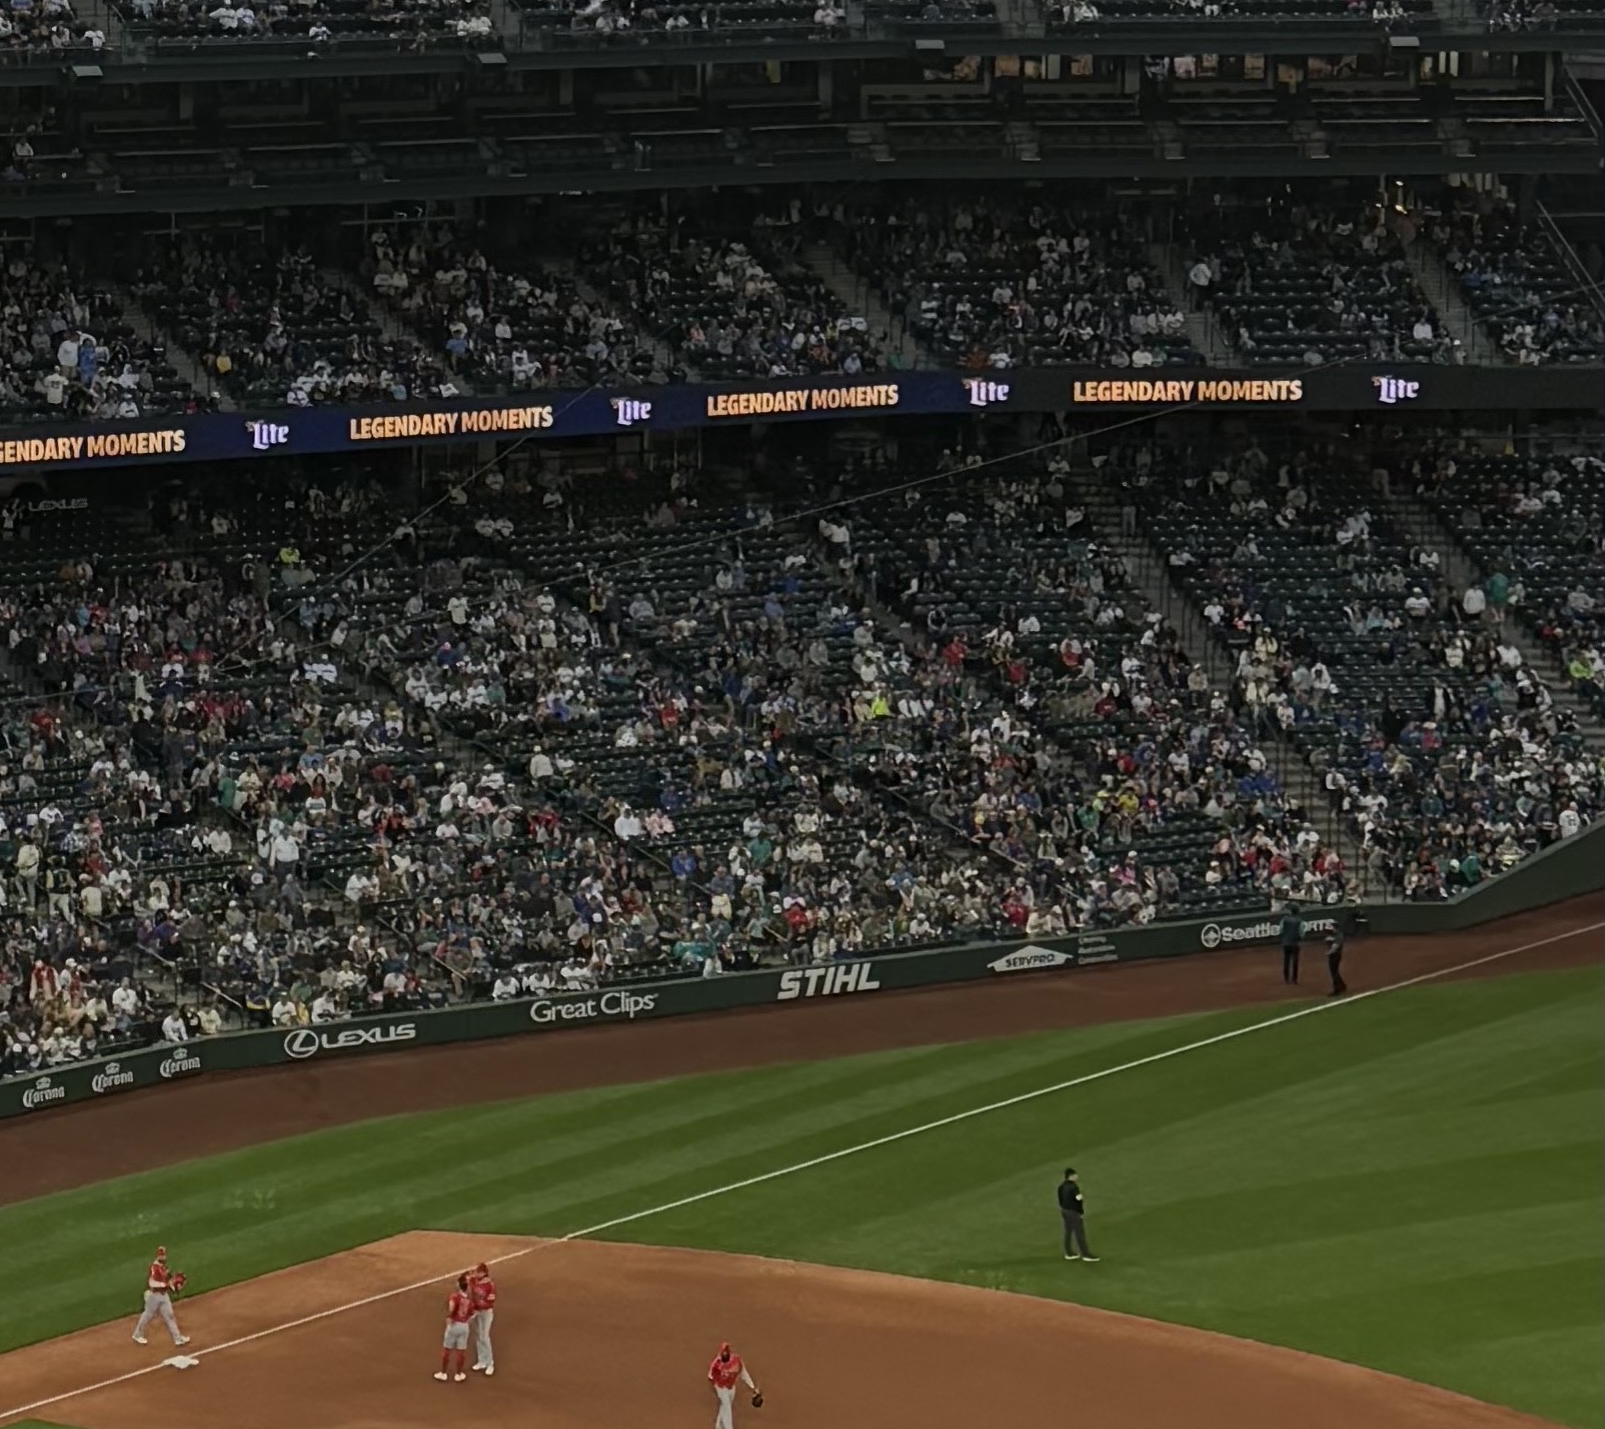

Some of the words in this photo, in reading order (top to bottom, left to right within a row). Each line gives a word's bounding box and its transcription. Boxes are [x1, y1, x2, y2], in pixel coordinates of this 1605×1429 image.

[708, 391, 808, 417] LEGENDARY
[812, 384, 899, 410] MOMENTS
[969, 379, 1010, 407] Lite
[1073, 381, 1194, 403] LEGENDARY
[1198, 379, 1303, 402] MOMENTS
[1378, 376, 1420, 404] Lite
[350, 413, 459, 440] LEGENDARY
[461, 406, 553, 433] MOMENTS
[617, 399, 652, 426] Lite
[88, 430, 186, 458] MOMENTS
[251, 422, 289, 451] Lite
[1221, 922, 1280, 942] Seattle
[777, 962, 880, 1000] STIHL
[530, 998, 597, 1024] Great
[600, 991, 656, 1019] Clips
[321, 1024, 416, 1049] LEXUS
[160, 1056, 201, 1078] Corona
[92, 1071, 134, 1093] Corona
[22, 1086, 65, 1109] Corona
